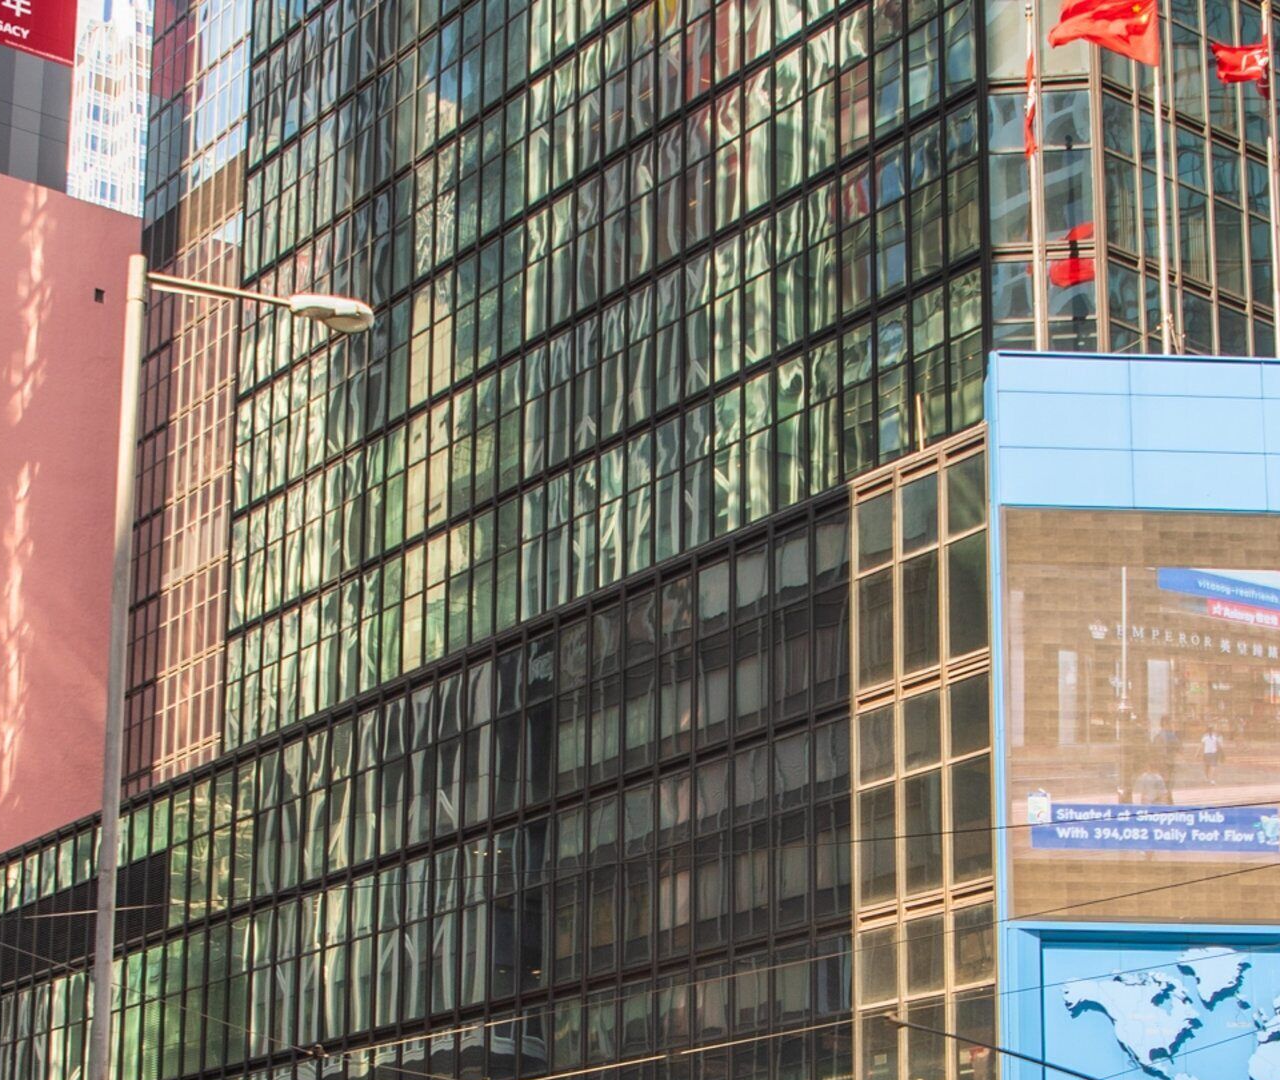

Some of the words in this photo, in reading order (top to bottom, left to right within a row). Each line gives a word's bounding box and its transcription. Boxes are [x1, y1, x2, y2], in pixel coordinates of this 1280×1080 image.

[1116, 624, 1212, 648] EMPEROR
[1055, 808, 1112, 821] Situated
[1135, 811, 1195, 825] Shopping
[1198, 812, 1225, 824] Hub
[1055, 827, 1089, 840] With
[1094, 827, 1149, 841] 394,082
[1154, 828, 1187, 843] Daily
[1191, 828, 1220, 841] Foot
[1224, 829, 1255, 842] Flow
